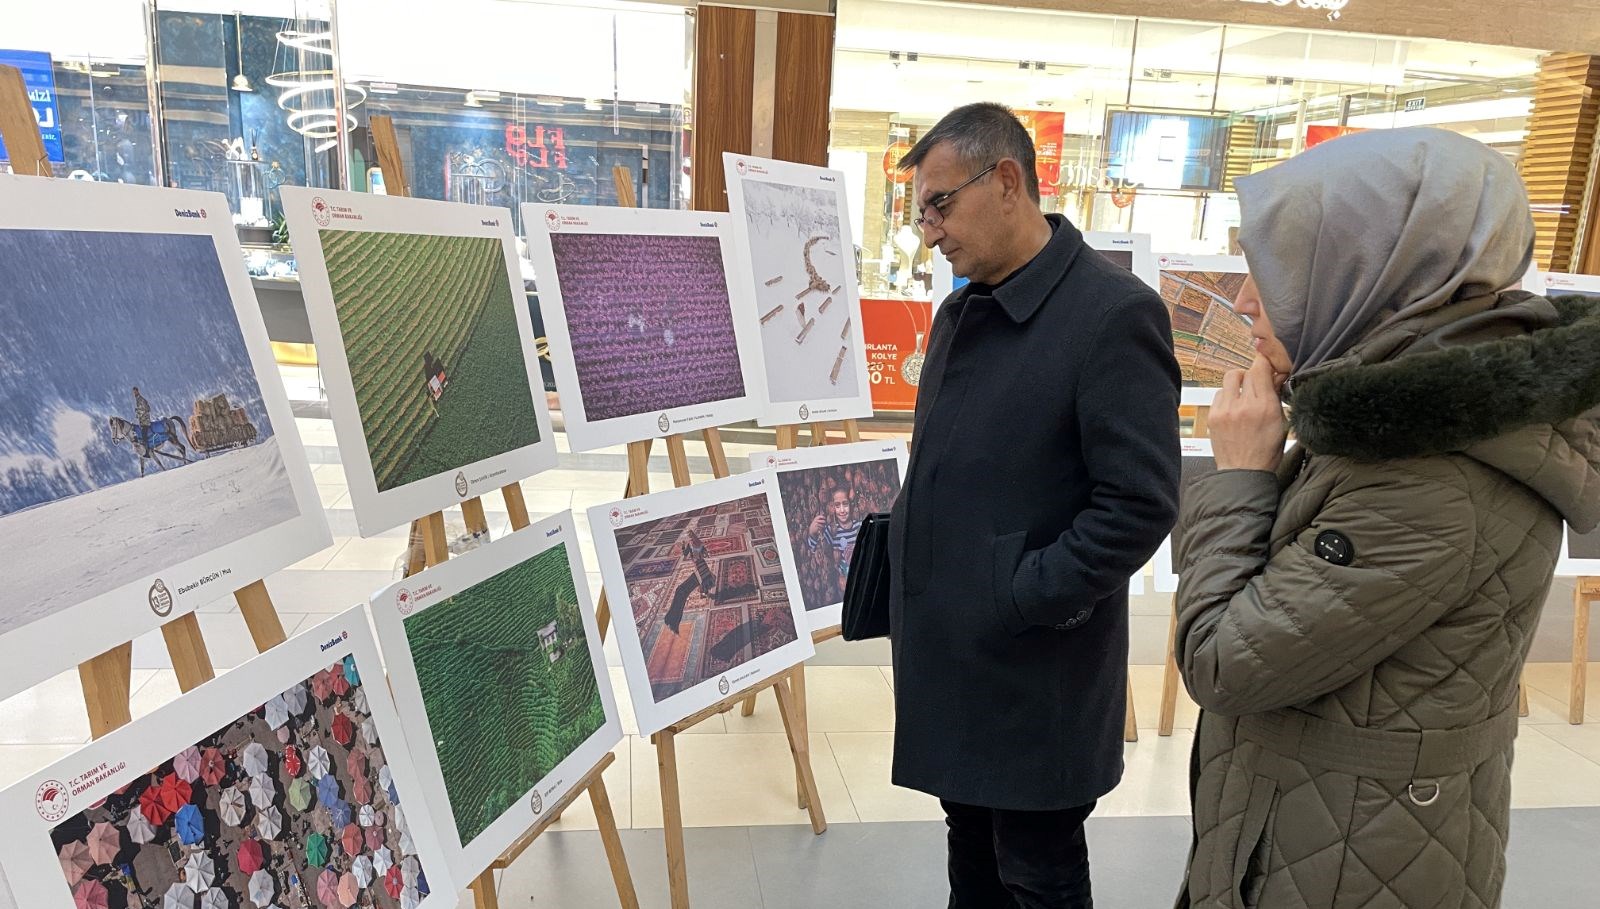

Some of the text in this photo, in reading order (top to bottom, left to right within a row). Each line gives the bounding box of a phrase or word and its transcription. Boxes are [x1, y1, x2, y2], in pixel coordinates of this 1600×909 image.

[885, 376, 896, 385] TL
[320, 635, 343, 652] DenizBank
[69, 778, 80, 788] T.C.
[80, 768, 99, 781] TARIM
[72, 762, 126, 796] ORMAN BAKANLIĞI
